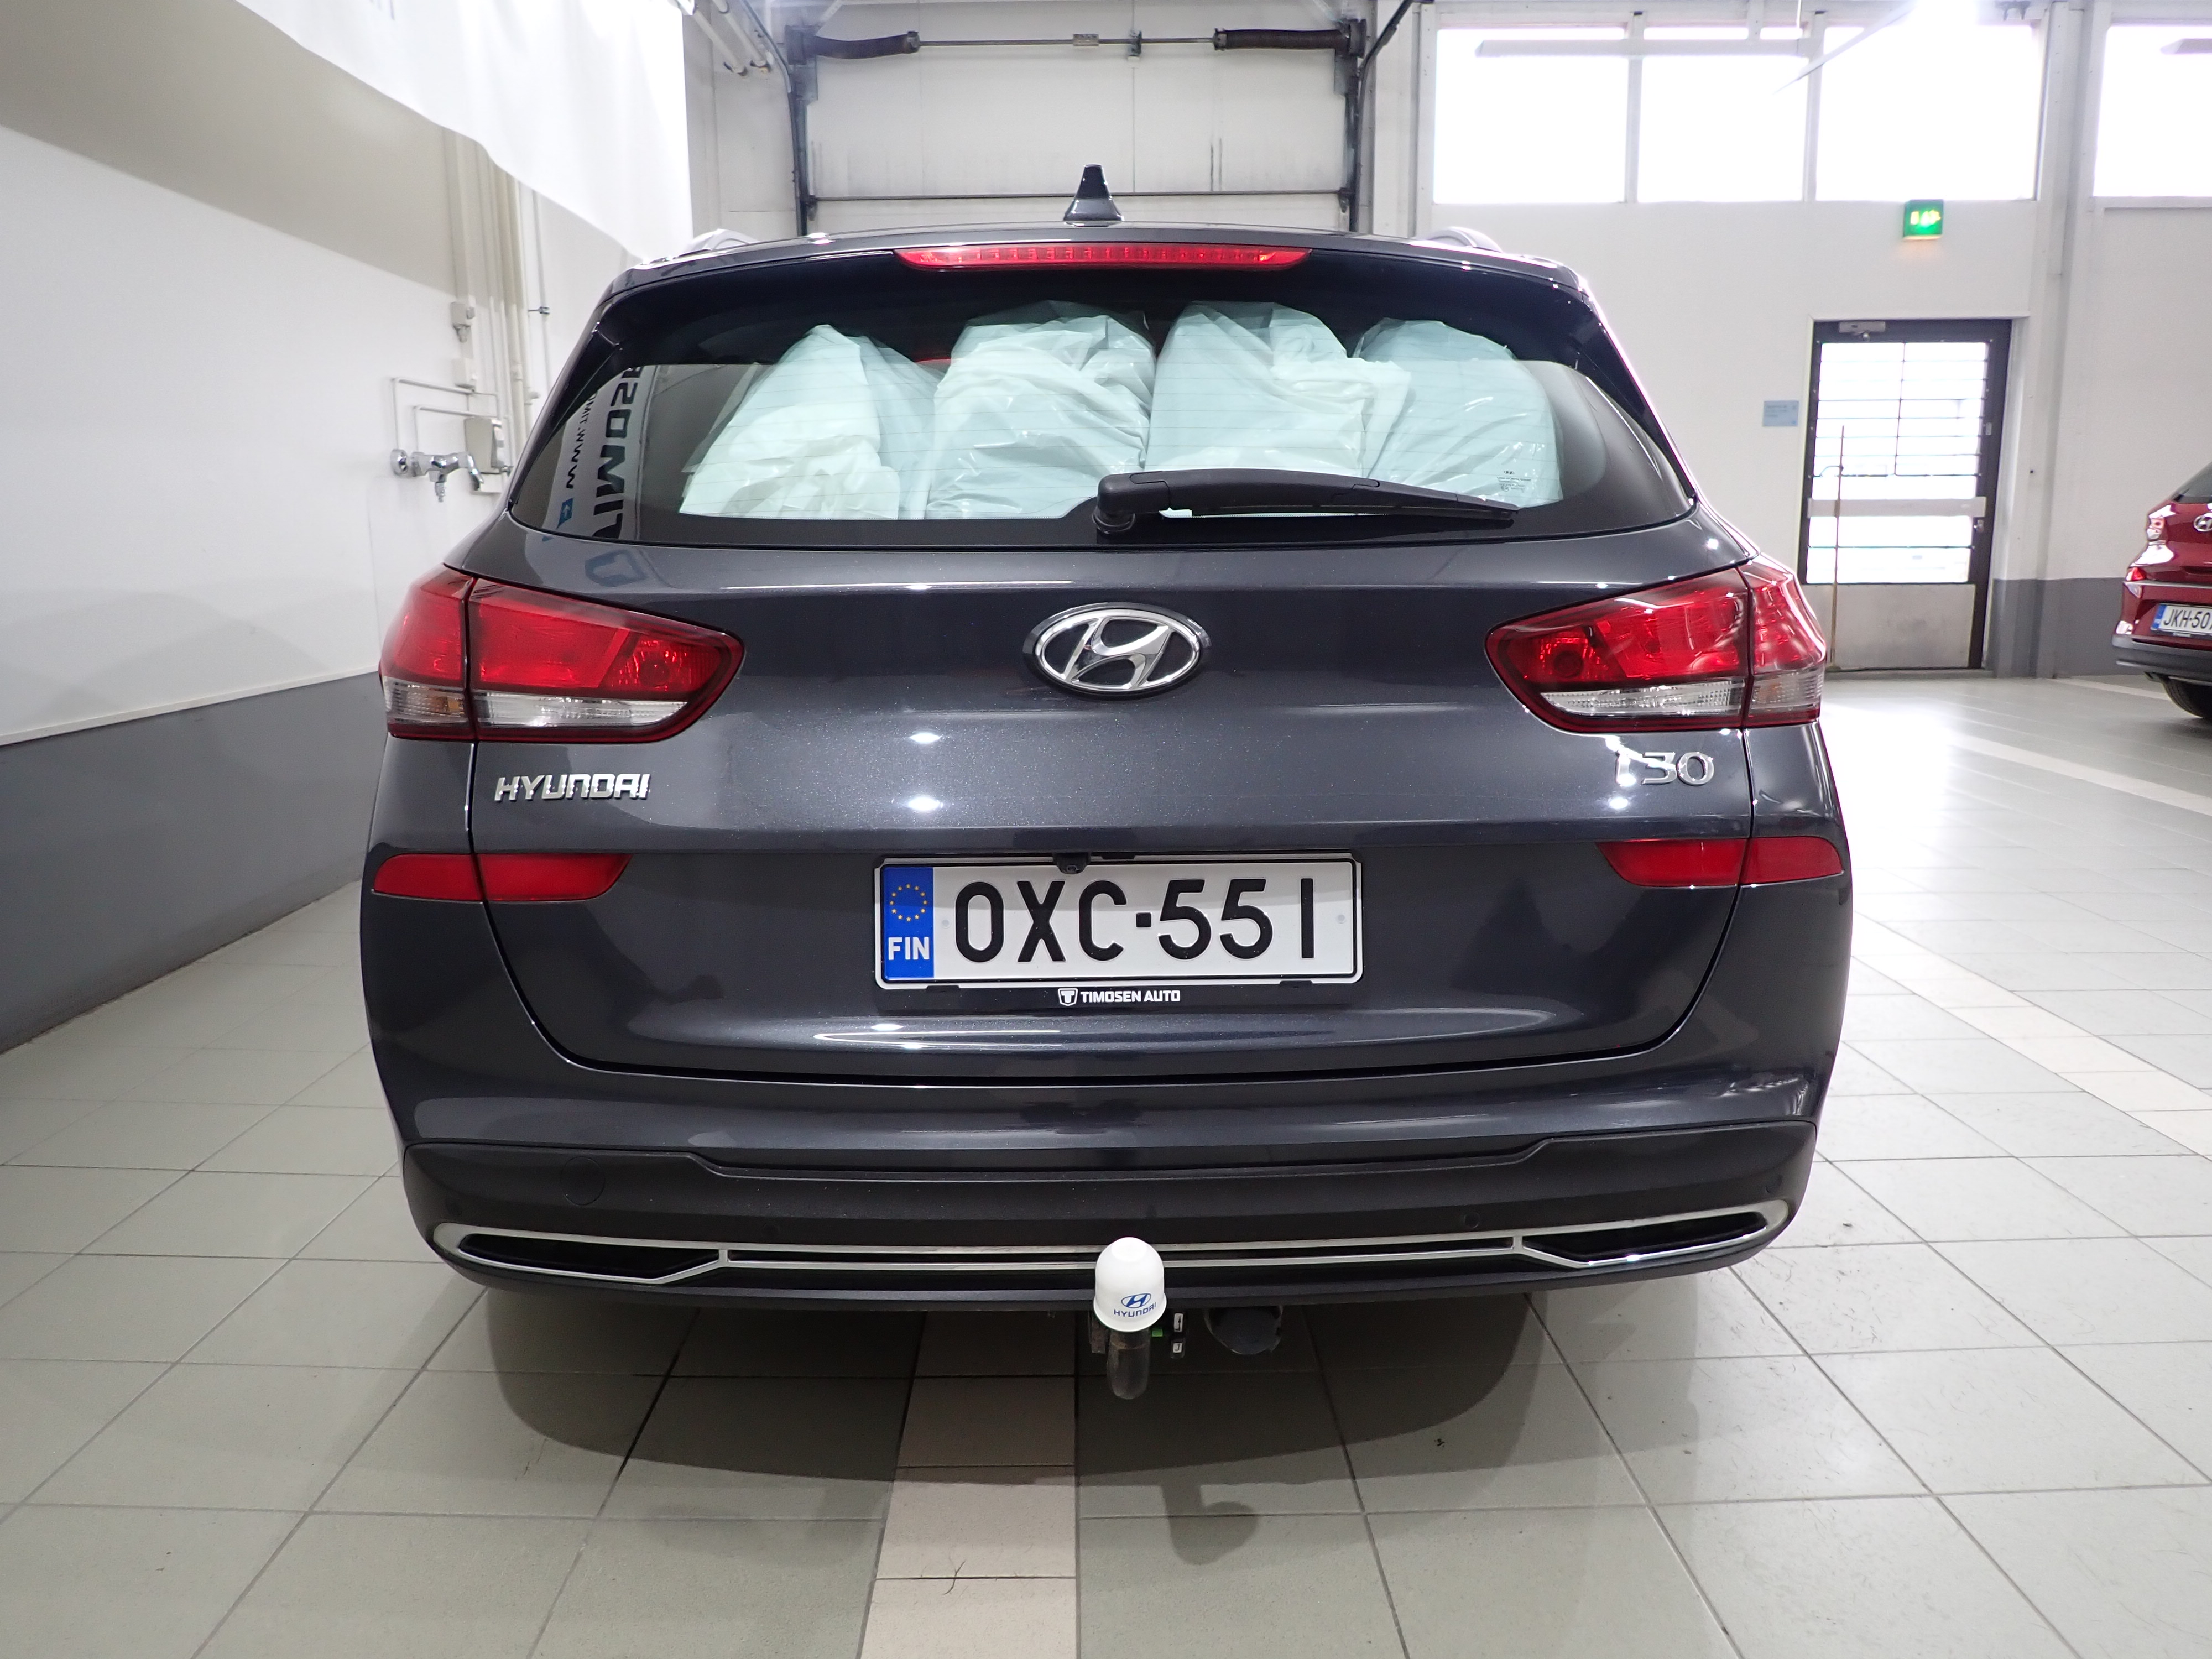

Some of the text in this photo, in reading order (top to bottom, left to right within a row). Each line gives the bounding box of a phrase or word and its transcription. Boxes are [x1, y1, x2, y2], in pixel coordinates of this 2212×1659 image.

[2163, 609, 2212, 630] JKH-50
[494, 774, 651, 801] HYUNDAI
[954, 878, 1314, 963] OXC-551
[888, 936, 930, 961] FIN
[1080, 990, 1141, 1003] TIMOSEN
[1143, 990, 1181, 1003] AUTO
[1113, 1302, 1156, 1317] HYUNDAI
